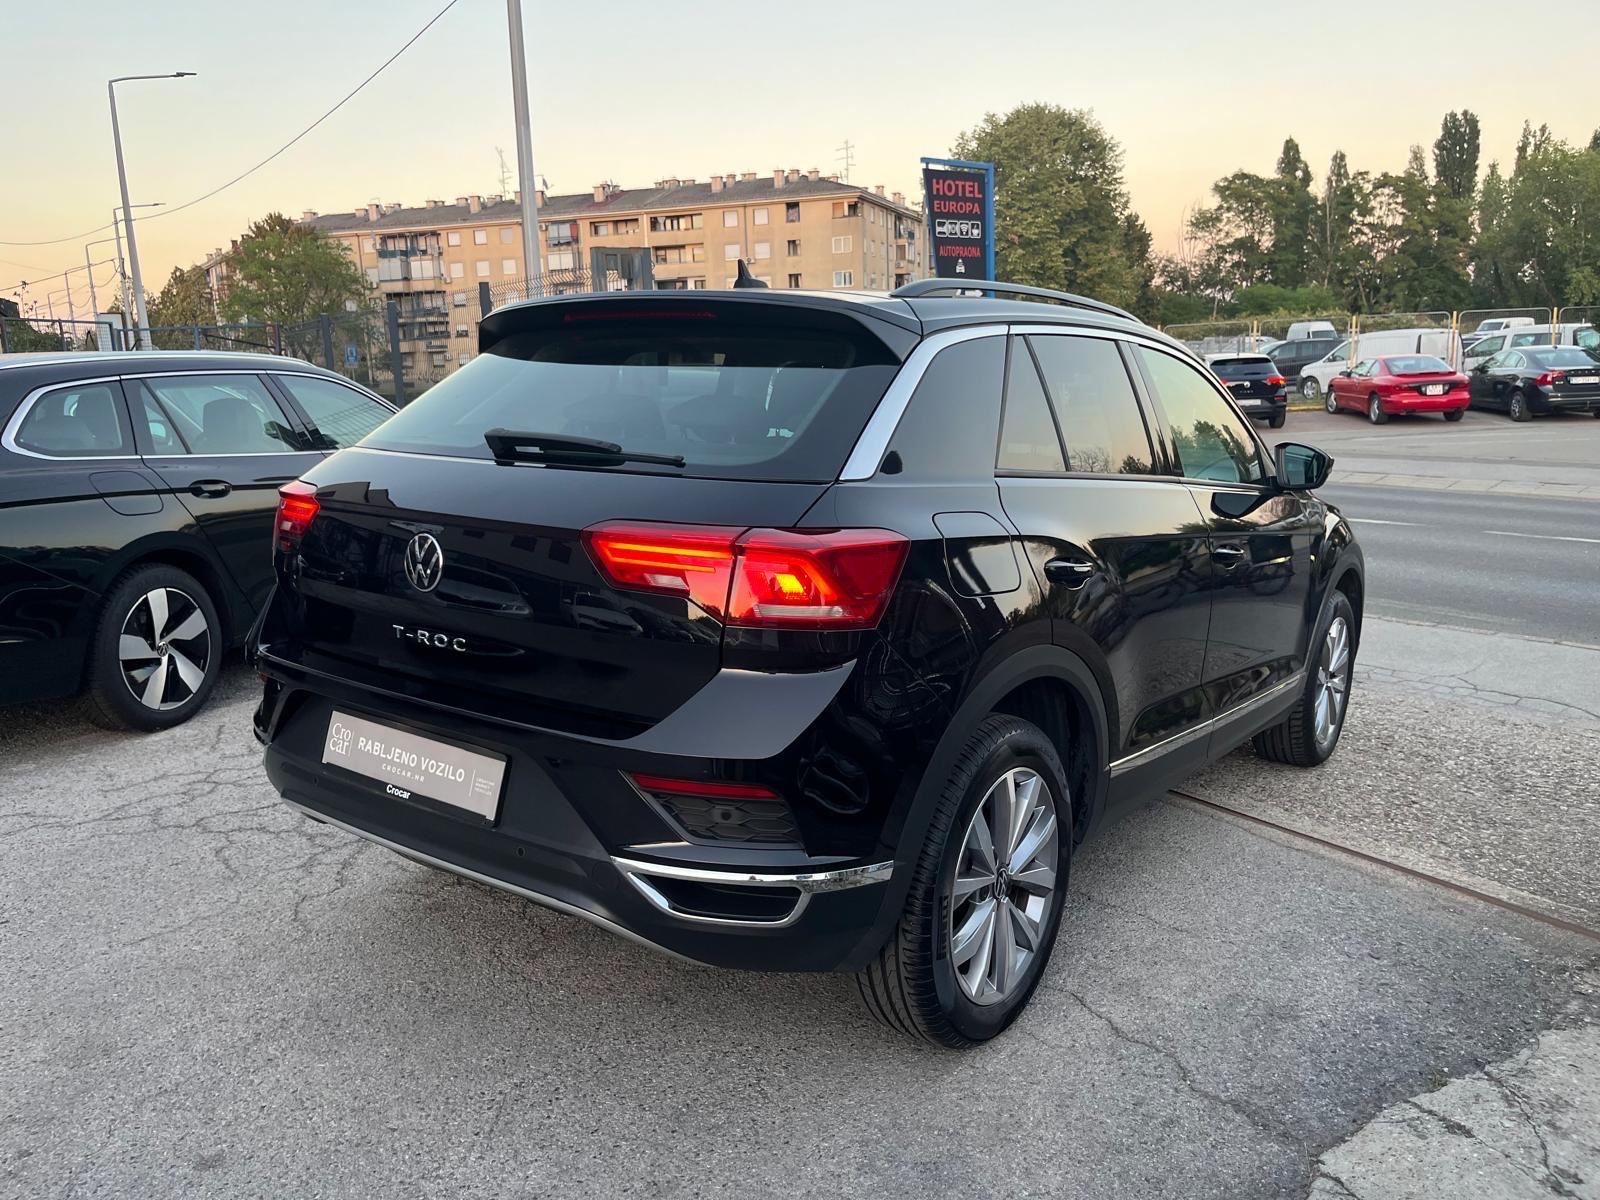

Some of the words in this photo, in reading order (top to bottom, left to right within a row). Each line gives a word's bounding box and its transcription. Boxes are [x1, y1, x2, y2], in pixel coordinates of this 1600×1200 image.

[932, 179, 982, 198] HOTEL
[934, 200, 980, 214] EUROPA
[393, 624, 466, 652] T-ROC
[332, 723, 351, 741] Cro
[329, 738, 349, 755] car
[358, 737, 417, 767] RABLJENO
[421, 757, 465, 782] VOZILO
[381, 763, 425, 782] CROCAR.HR
[386, 784, 411, 799] Crocar
